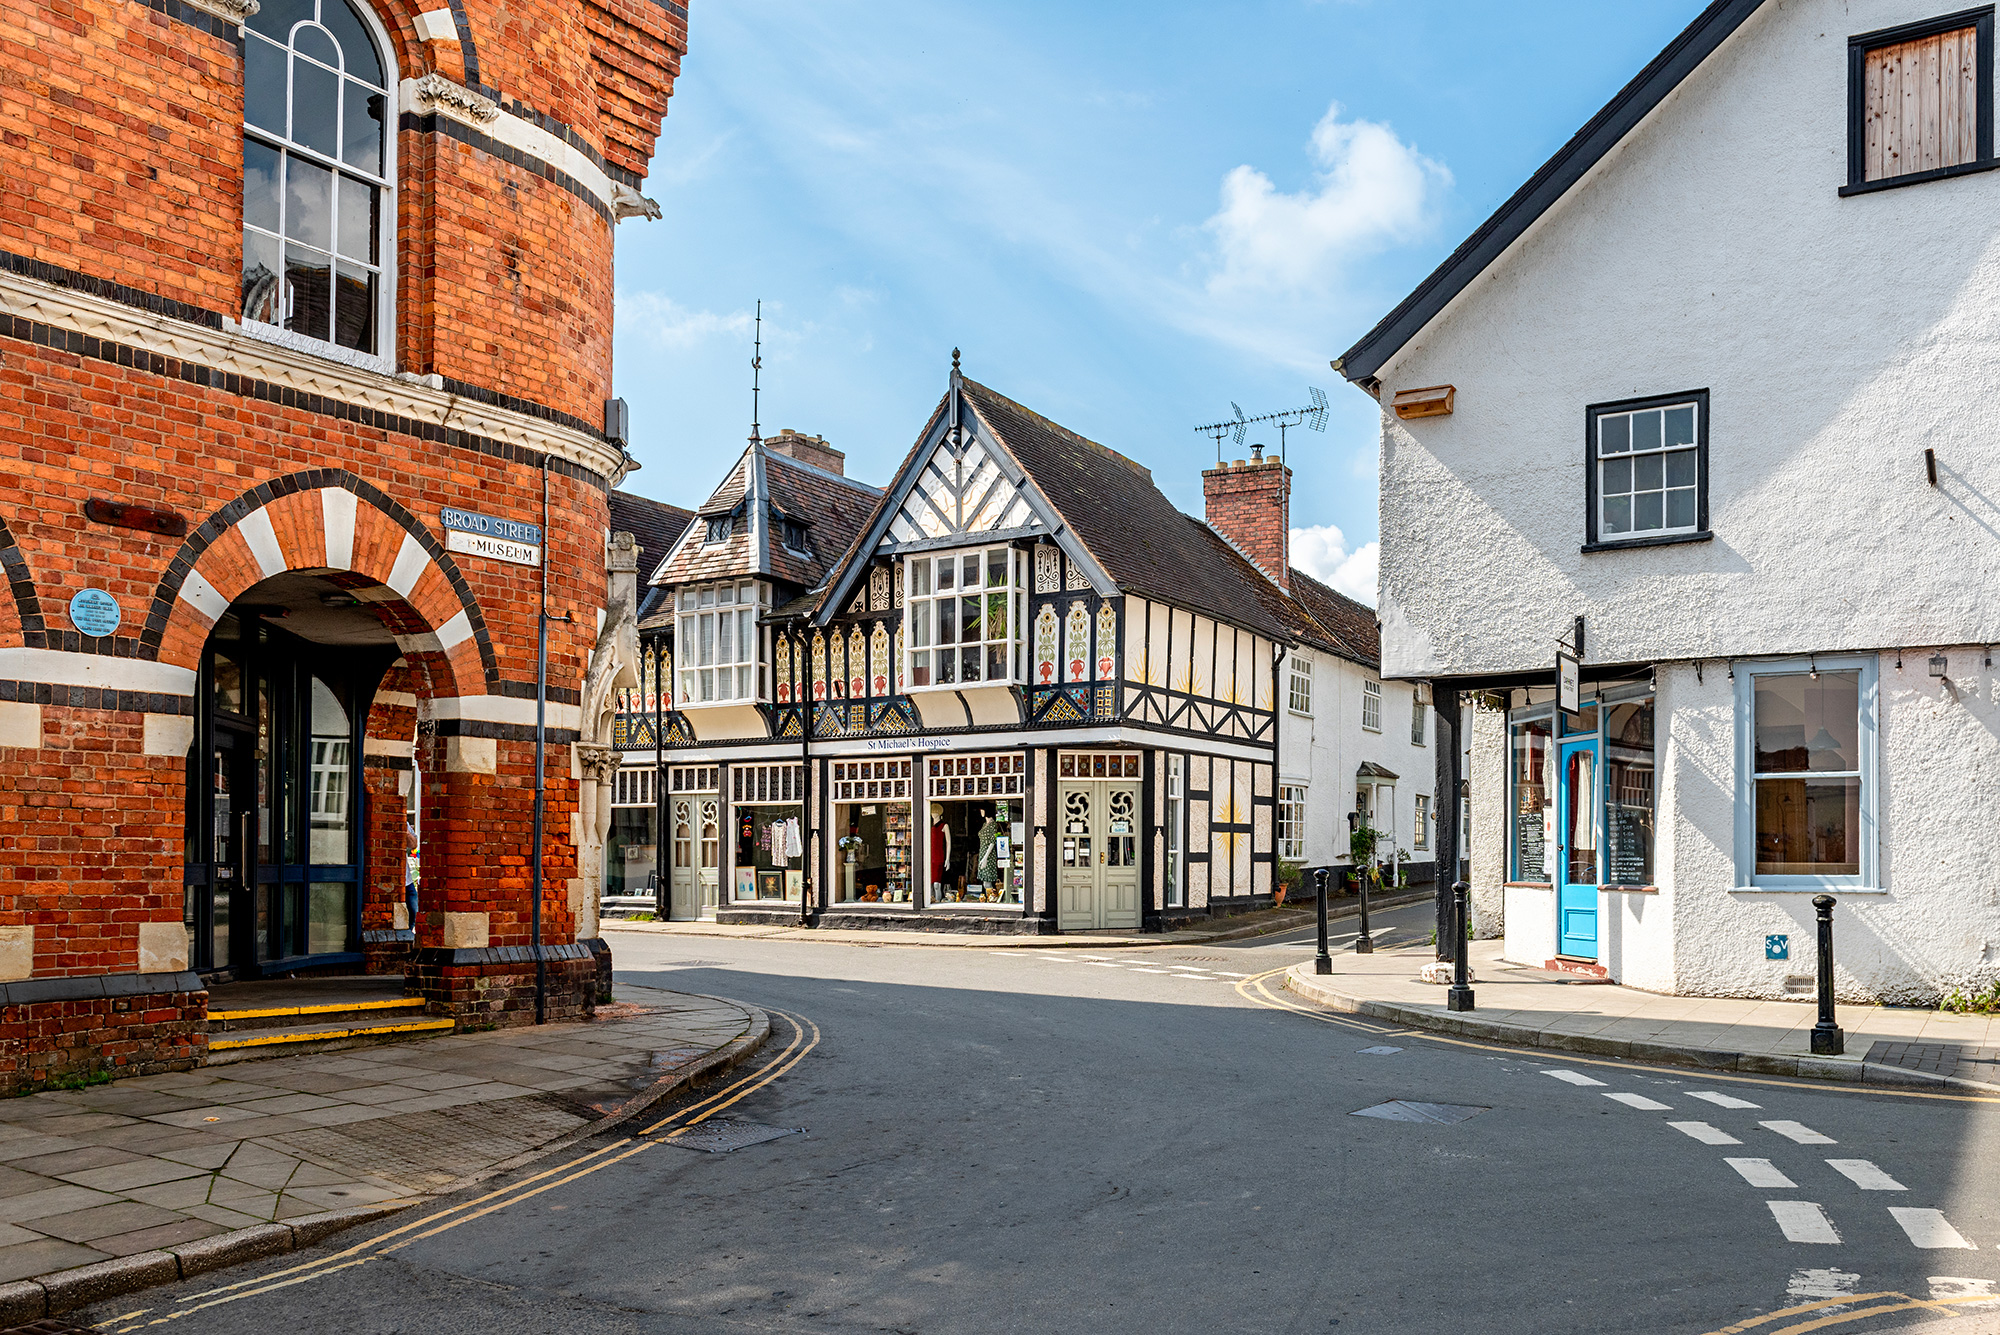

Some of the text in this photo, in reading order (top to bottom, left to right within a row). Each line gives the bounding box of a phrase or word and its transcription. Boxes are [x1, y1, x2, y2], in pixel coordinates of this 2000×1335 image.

[445, 510, 537, 542] BROAD STREET
[476, 539, 533, 561] MUSEUM
[867, 737, 951, 750] St Michael's Hospice
[1766, 939, 1788, 949] S V
